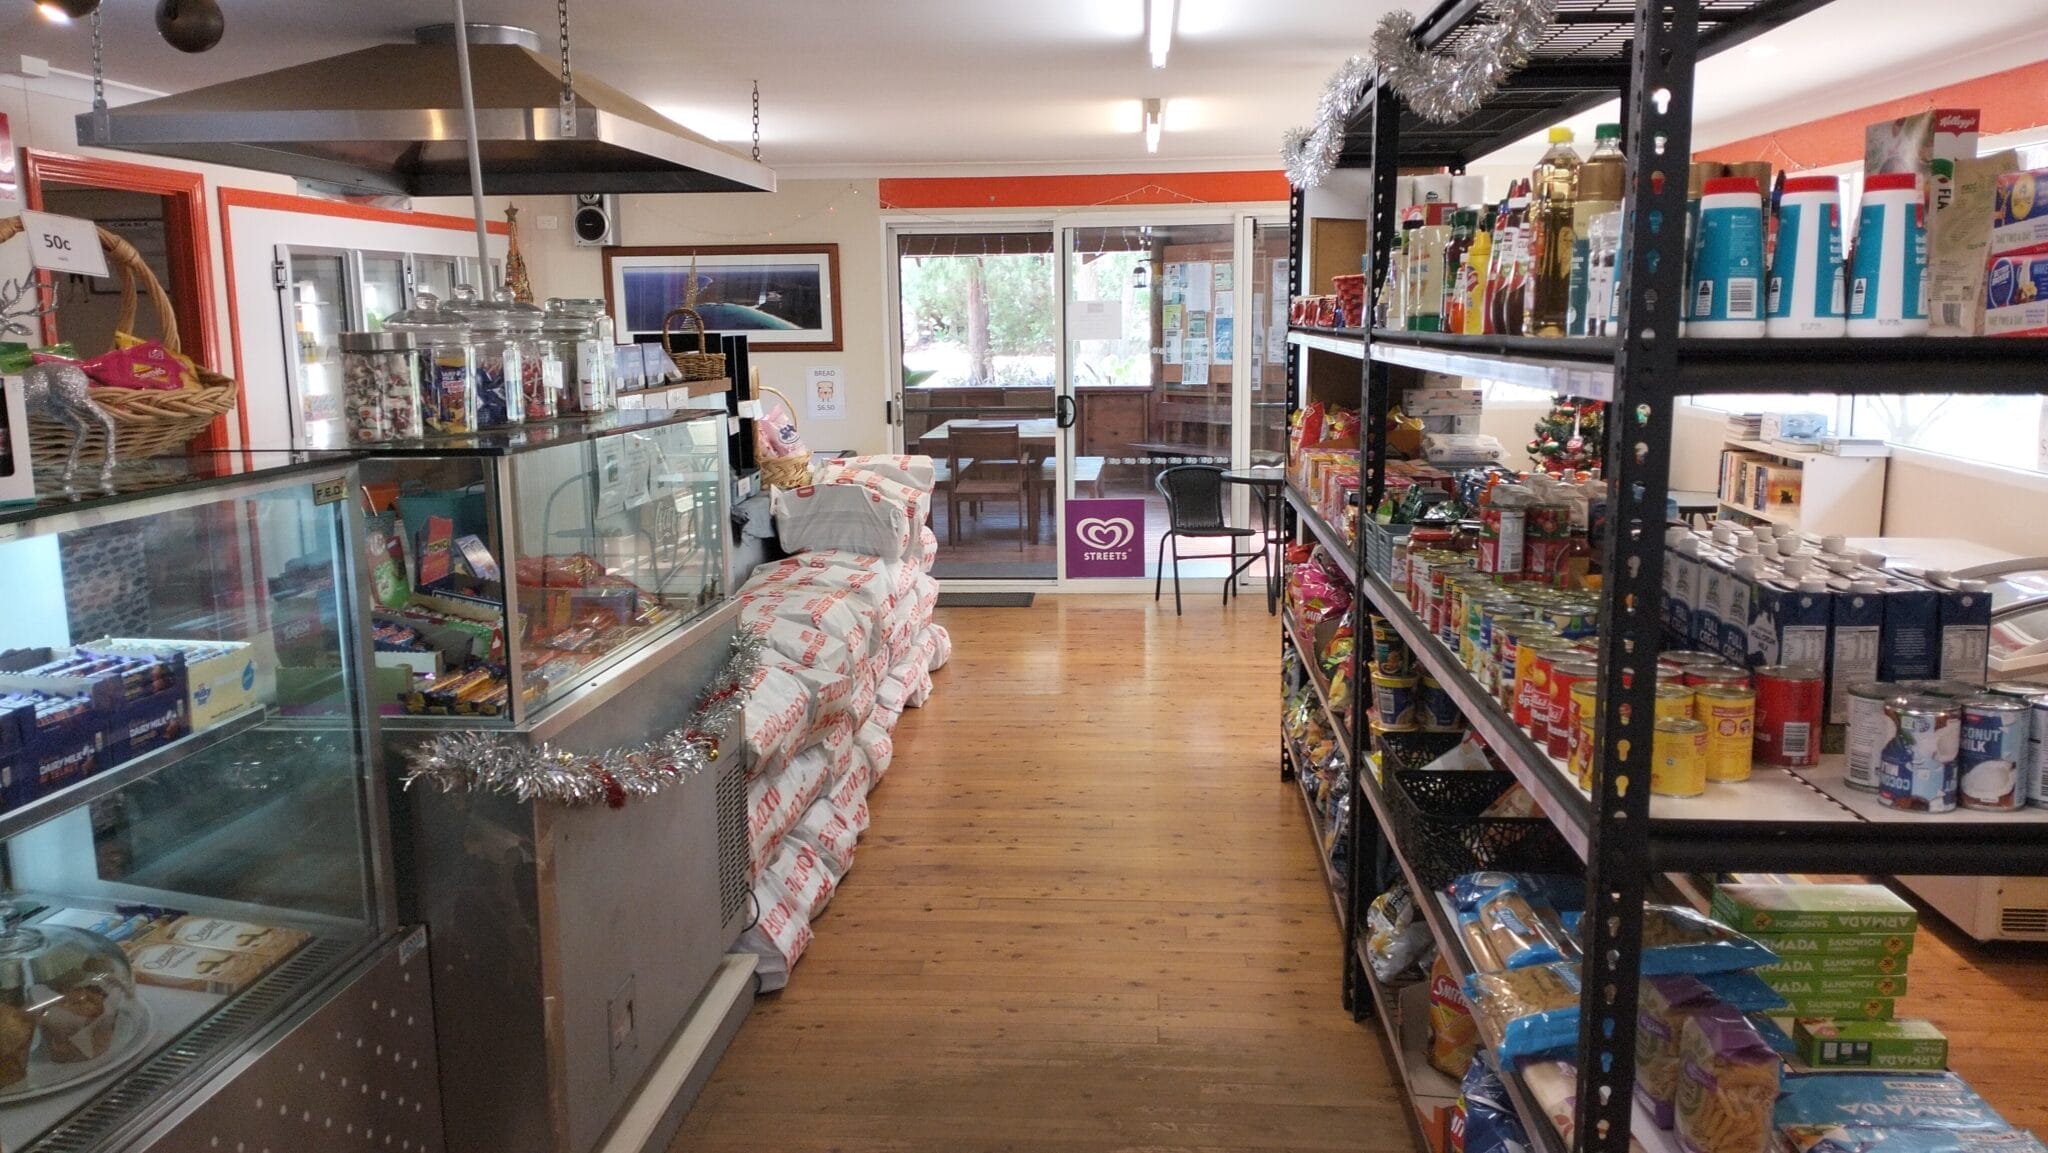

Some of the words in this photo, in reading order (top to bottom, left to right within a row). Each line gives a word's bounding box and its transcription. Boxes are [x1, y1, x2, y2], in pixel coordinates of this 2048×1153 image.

[43, 233, 72, 251] 50c
[1084, 551, 1127, 560] STREETS
[1838, 916, 1911, 928] ARMADA
[1762, 939, 1818, 951] RMADA
[1828, 938, 1881, 947] SANDWICH
[1823, 958, 1875, 968] SANDWICH
[1821, 980, 1874, 989] SANDWICH
[1878, 1055, 1942, 1065] ARMADA
[1836, 1103, 1984, 1119] ARMADA
